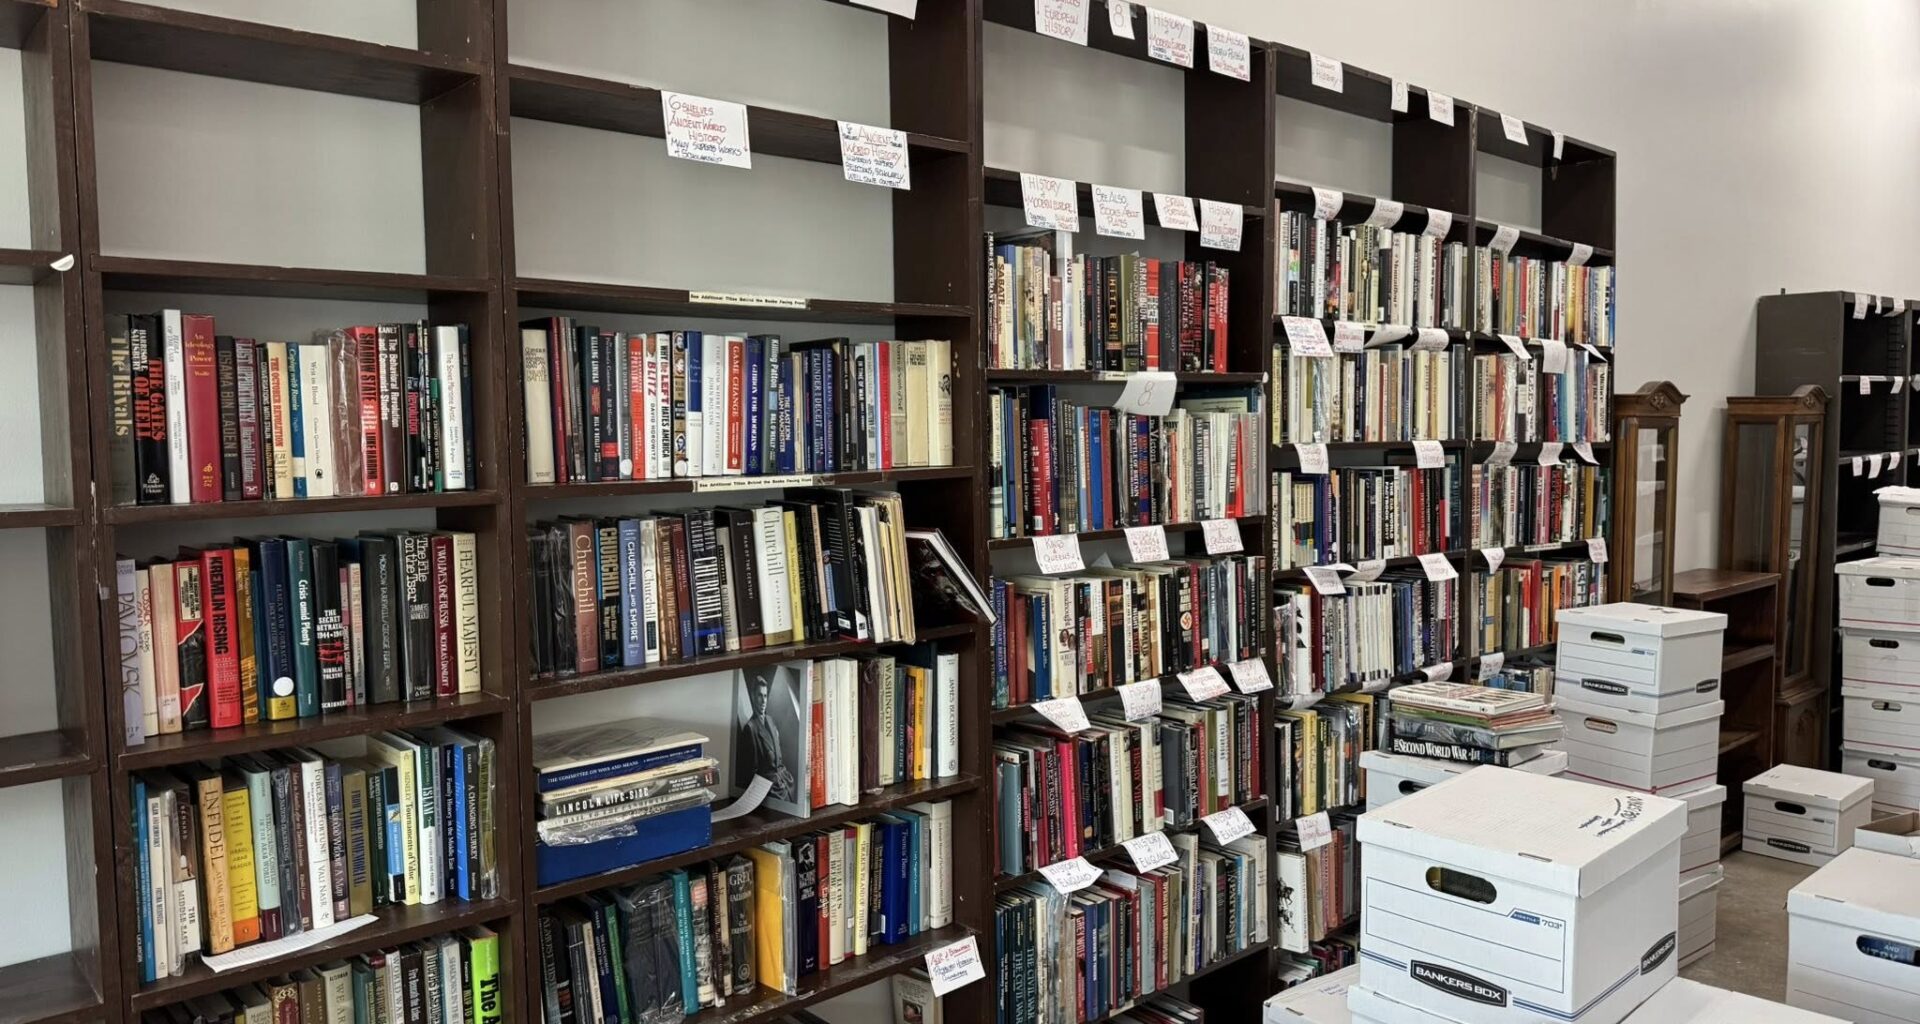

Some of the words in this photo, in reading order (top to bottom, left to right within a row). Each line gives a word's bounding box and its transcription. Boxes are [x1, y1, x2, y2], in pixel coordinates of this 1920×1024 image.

[1045, 19, 1075, 39] HISTORY
[1113, 4, 1124, 27] 8
[669, 95, 681, 110] 6
[682, 103, 713, 115] SHELVES
[689, 130, 725, 145] HISTORY
[1029, 176, 1061, 196] HISTORY
[1109, 279, 1118, 330] HITLER
[111, 336, 132, 371] The
[131, 328, 140, 371] SALISBURY
[139, 329, 147, 365] HARRISON
[236, 342, 254, 365] LOST
[360, 333, 376, 372] SHADOW
[379, 338, 387, 351] and
[389, 339, 398, 352] The
[591, 336, 599, 359] KILLING
[660, 345, 669, 360] WHY
[770, 340, 778, 363] Killing
[149, 359, 164, 389] THE
[219, 351, 236, 387] OSAMA
[271, 357, 280, 371] THE
[380, 354, 388, 392] Communist
[390, 354, 399, 389] Behavioral
[591, 360, 599, 383] LINCOLN
[647, 361, 657, 397] BLITZ
[661, 361, 670, 373] the
[770, 364, 779, 388] Patton
[813, 353, 821, 391] PLUNDER
[134, 376, 149, 395] OF
[222, 391, 236, 409] BIN
[239, 366, 256, 423] OPPORTUNITY
[272, 373, 281, 403] OCTOBER
[311, 386, 319, 405] Blood
[361, 375, 376, 401] STATE
[661, 374, 669, 405] LEFT
[112, 375, 133, 436] Rivals
[135, 401, 151, 440] HELL
[150, 392, 166, 440] GATES
[381, 394, 389, 420] Studies
[391, 392, 400, 427] Revolution
[408, 392, 419, 434] Revolution
[661, 406, 670, 426] HATES
[223, 413, 237, 449] LADEN
[273, 405, 283, 447] REVOLUTION
[366, 432, 377, 449] LUKE
[662, 428, 670, 458] AMERICA
[367, 449, 378, 479] HARDING
[1133, 459, 1138, 467] OF
[405, 537, 414, 552] on
[417, 537, 427, 557] The
[690, 520, 705, 552] GILBERT
[703, 520, 716, 550] MARTIN
[762, 510, 785, 576] Churchill
[405, 553, 417, 573] the
[418, 559, 429, 582] File
[575, 534, 595, 614] Churchill
[600, 527, 620, 600] CHURCHILL
[627, 542, 636, 593] CHURCHILL
[209, 556, 226, 613] KREMLIN
[299, 580, 309, 600] Crisis
[406, 574, 418, 602] Tsar
[460, 549, 475, 610] FEARFUL
[643, 569, 656, 620] Churchill
[693, 556, 722, 623] CHURCHILL
[300, 601, 309, 620] amid
[1062, 583, 1072, 626] Dreadnought
[213, 614, 229, 655] RISING
[300, 622, 311, 646] Plenty
[630, 608, 638, 641] EMPIRE
[119, 592, 140, 696] PAVLOVSK
[461, 615, 478, 674] MAJESTY
[884, 663, 893, 738] WASHINGTON
[1583, 681, 1611, 690] BANKERS
[1399, 739, 1425, 755] SECOND
[1425, 742, 1451, 758] WORLD
[1451, 746, 1467, 760] WAR
[422, 787, 434, 815] ISLAM
[468, 792, 476, 830] CHANGING
[205, 789, 224, 866] INFIDEL
[405, 803, 415, 850] Tournaments
[1222, 823, 1248, 840] ENGLAND
[470, 831, 478, 860] TURKEY
[1140, 851, 1170, 868] ENGLAND
[407, 860, 416, 880] Value
[1027, 946, 1035, 970] THE
[1884, 944, 1900, 953] AND
[480, 973, 499, 1013] The
[1027, 972, 1035, 997] CIVIL
[1415, 965, 1473, 992] BANKERS
[1474, 983, 1502, 1001] BOX
[1027, 998, 1035, 1019] WAR
